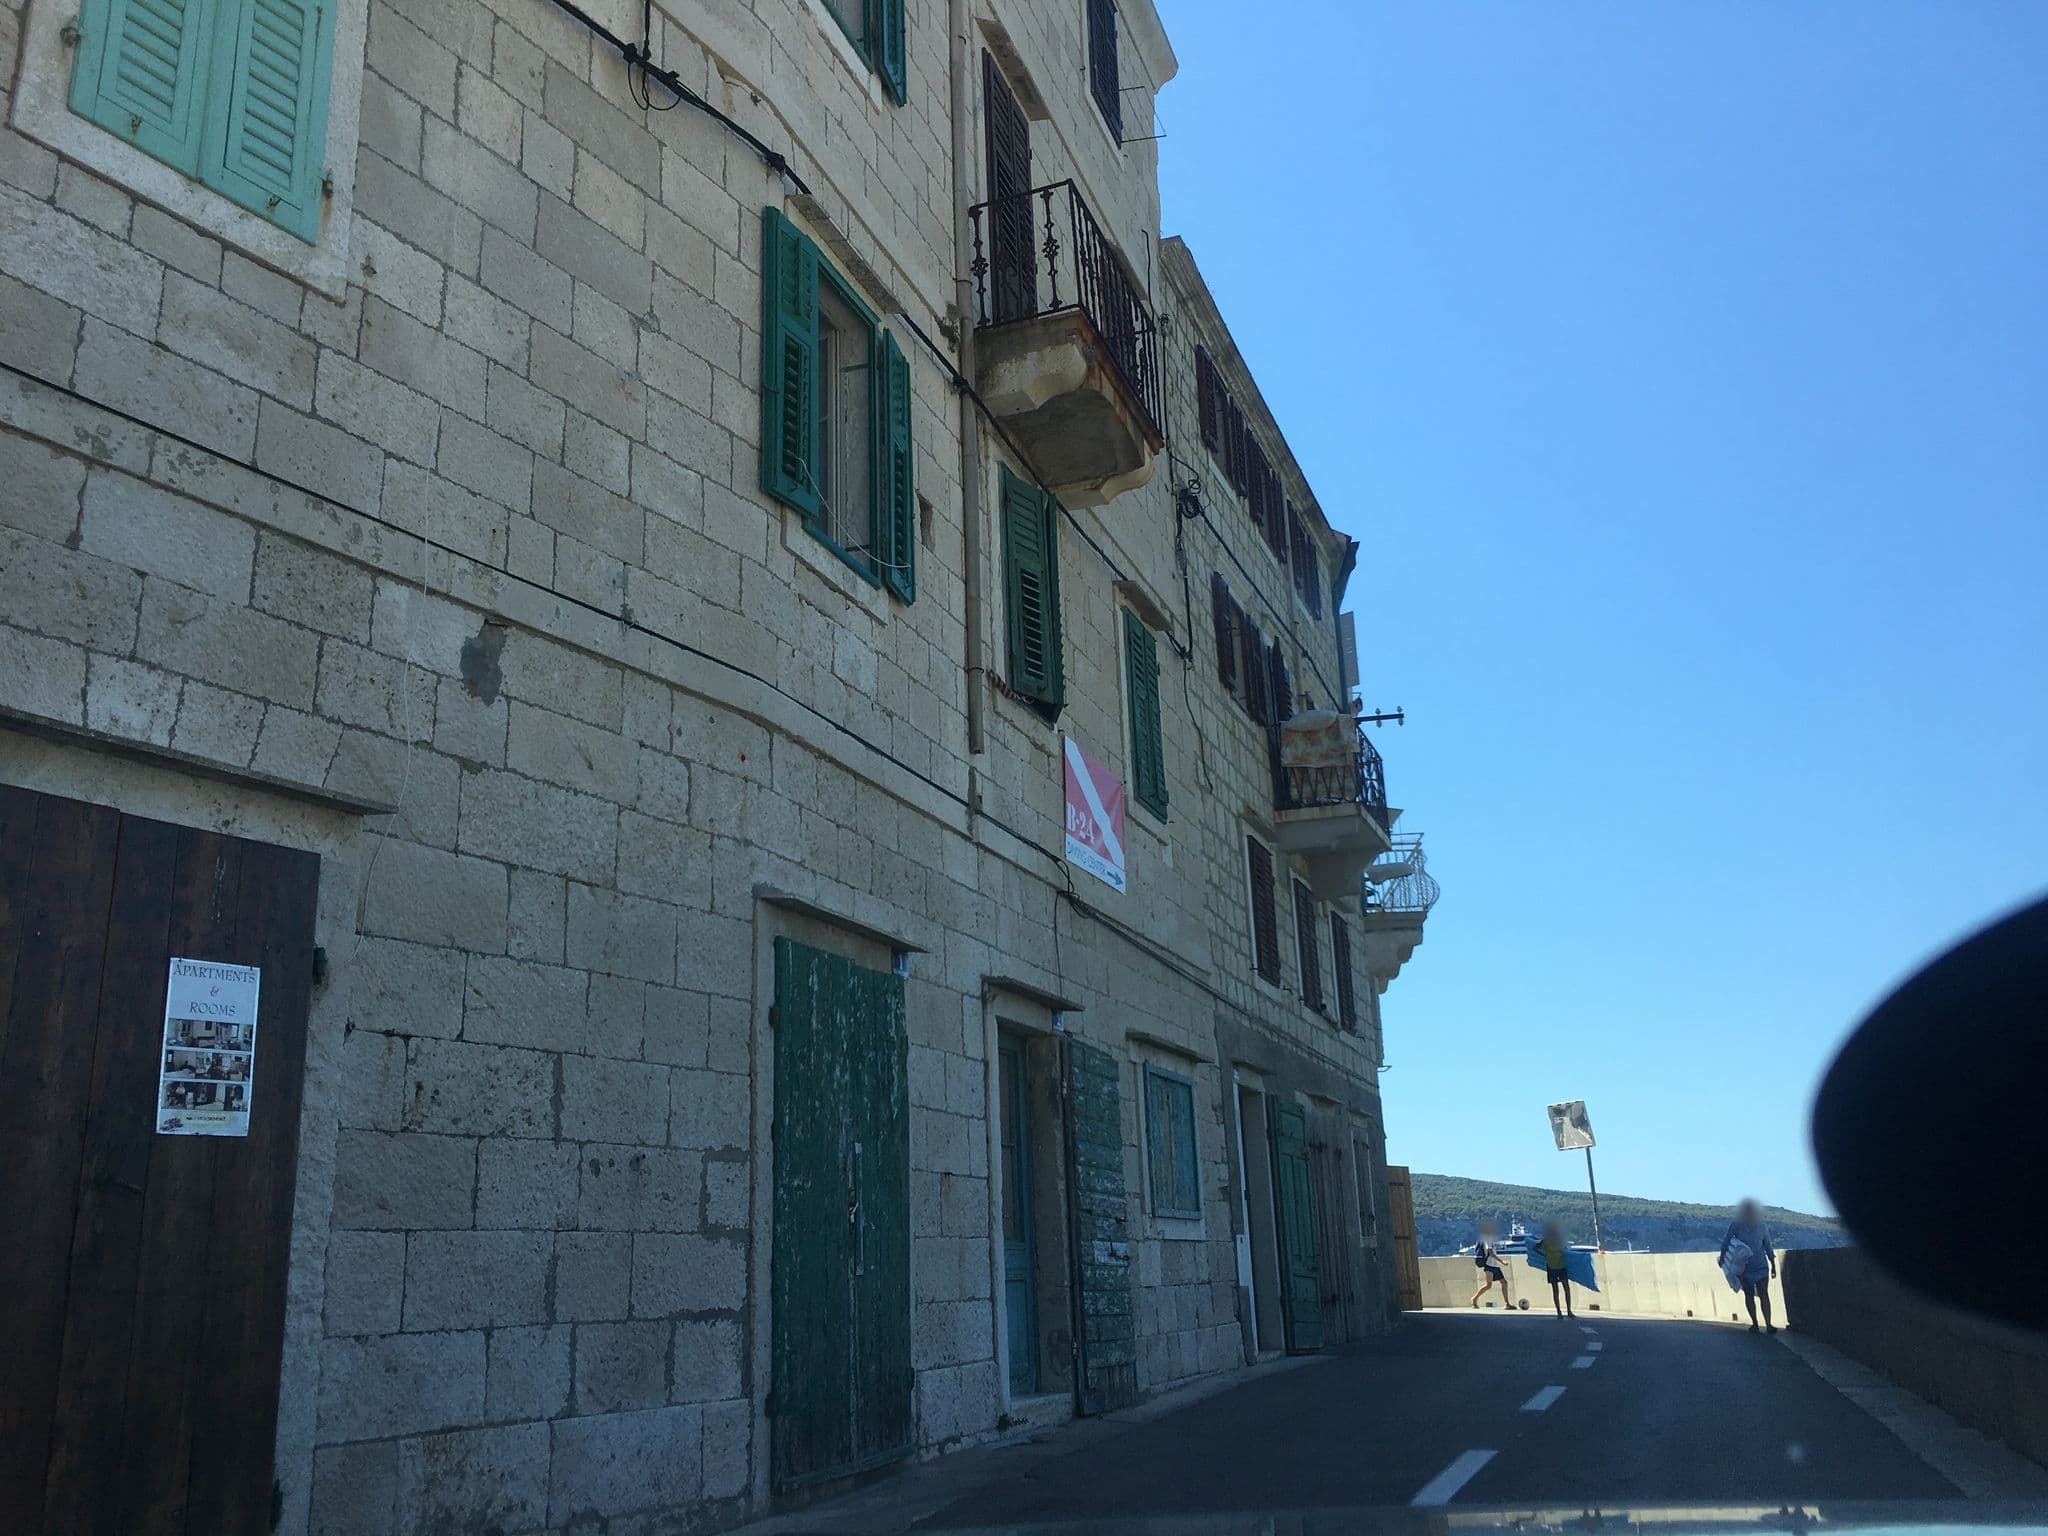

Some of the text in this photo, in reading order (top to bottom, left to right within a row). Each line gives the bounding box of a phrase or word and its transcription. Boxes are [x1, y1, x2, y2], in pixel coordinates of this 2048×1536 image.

[1066, 802, 1095, 844] B-24
[173, 963, 256, 984] APARTMENTS
[210, 985, 219, 997] &
[190, 1002, 236, 1016] ROOMS
